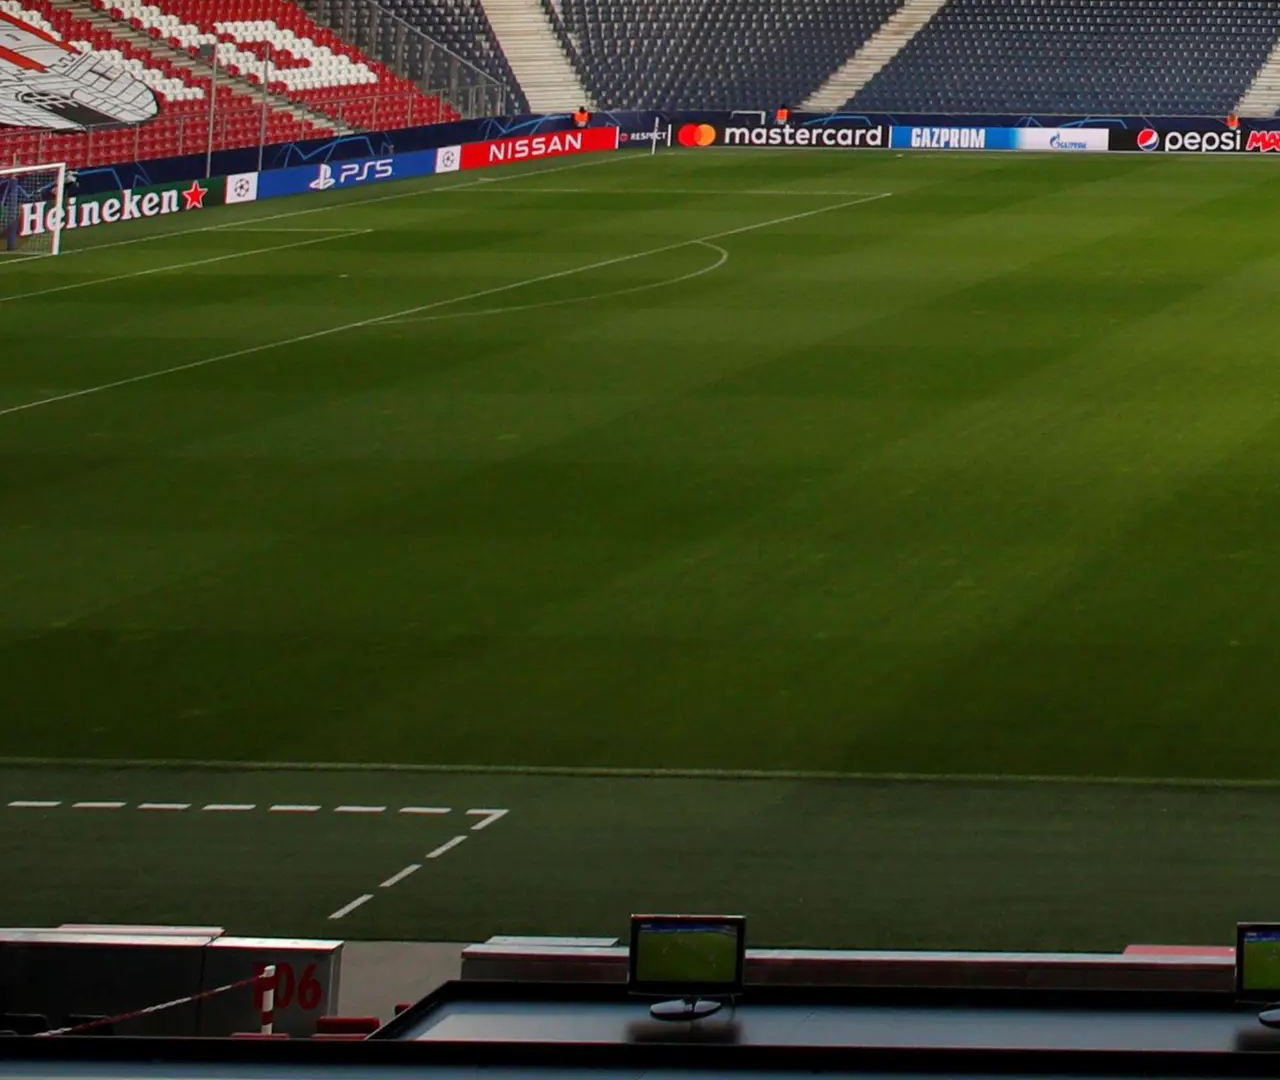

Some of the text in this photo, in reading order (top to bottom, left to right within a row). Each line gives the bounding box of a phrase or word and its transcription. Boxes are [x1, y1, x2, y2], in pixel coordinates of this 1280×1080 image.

[630, 131, 668, 142] RESPECT
[723, 123, 882, 146] mastercard
[911, 127, 985, 148] GAZPROM
[1164, 128, 1241, 152] pepsi
[489, 133, 582, 162] NISSAN
[340, 159, 393, 183] PS5
[20, 187, 179, 237] Heineken
